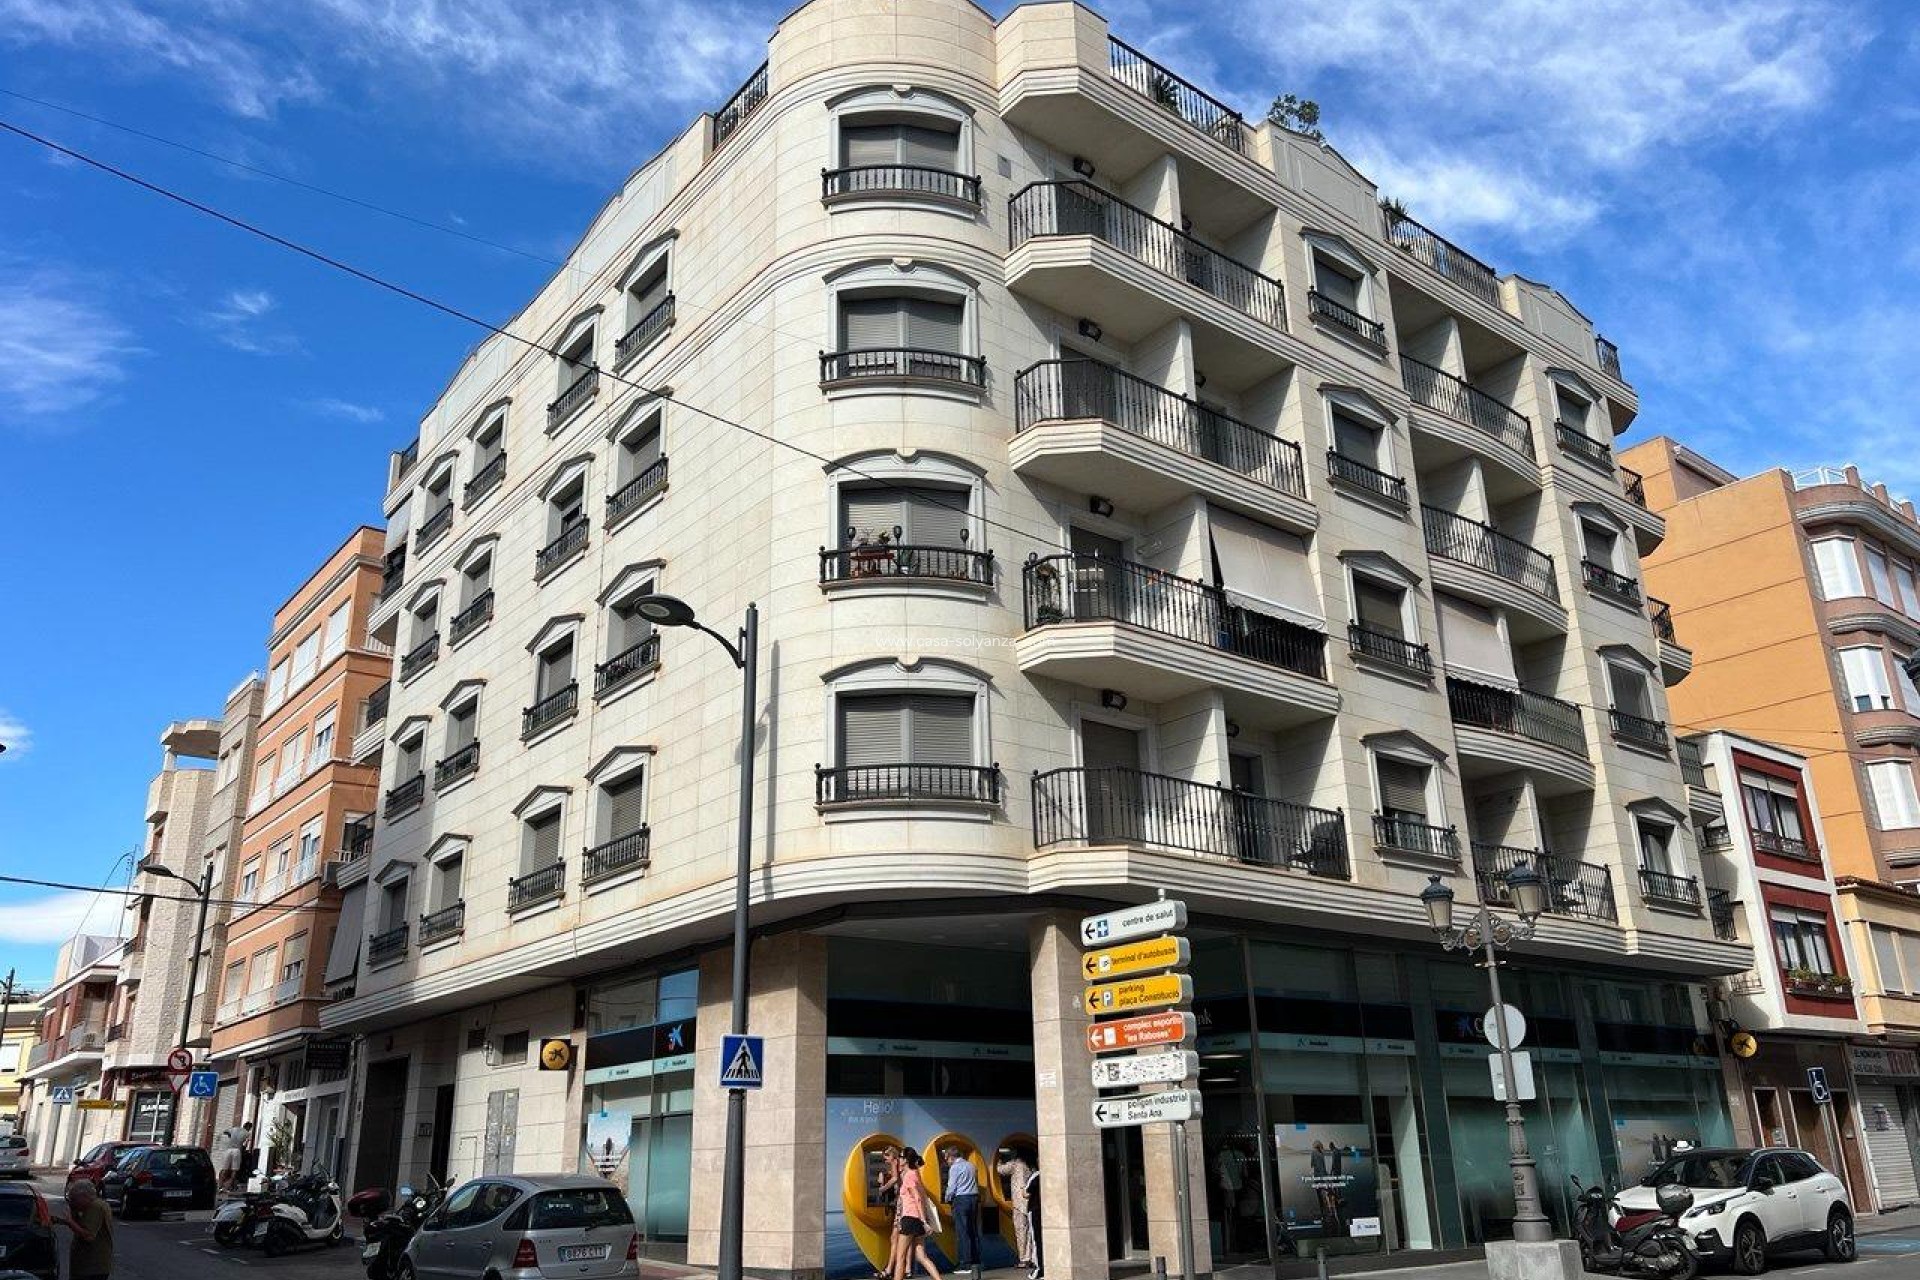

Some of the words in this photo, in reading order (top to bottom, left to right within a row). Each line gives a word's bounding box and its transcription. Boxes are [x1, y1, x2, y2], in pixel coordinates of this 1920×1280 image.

[1121, 916, 1144, 928] centre
[1145, 912, 1154, 922] de
[1155, 908, 1174, 920] salut
[1118, 983, 1146, 995] parking
[1154, 1092, 1187, 1105] industrial
[1127, 1110, 1148, 1121] Santa
[1148, 1108, 1163, 1119] Ana
